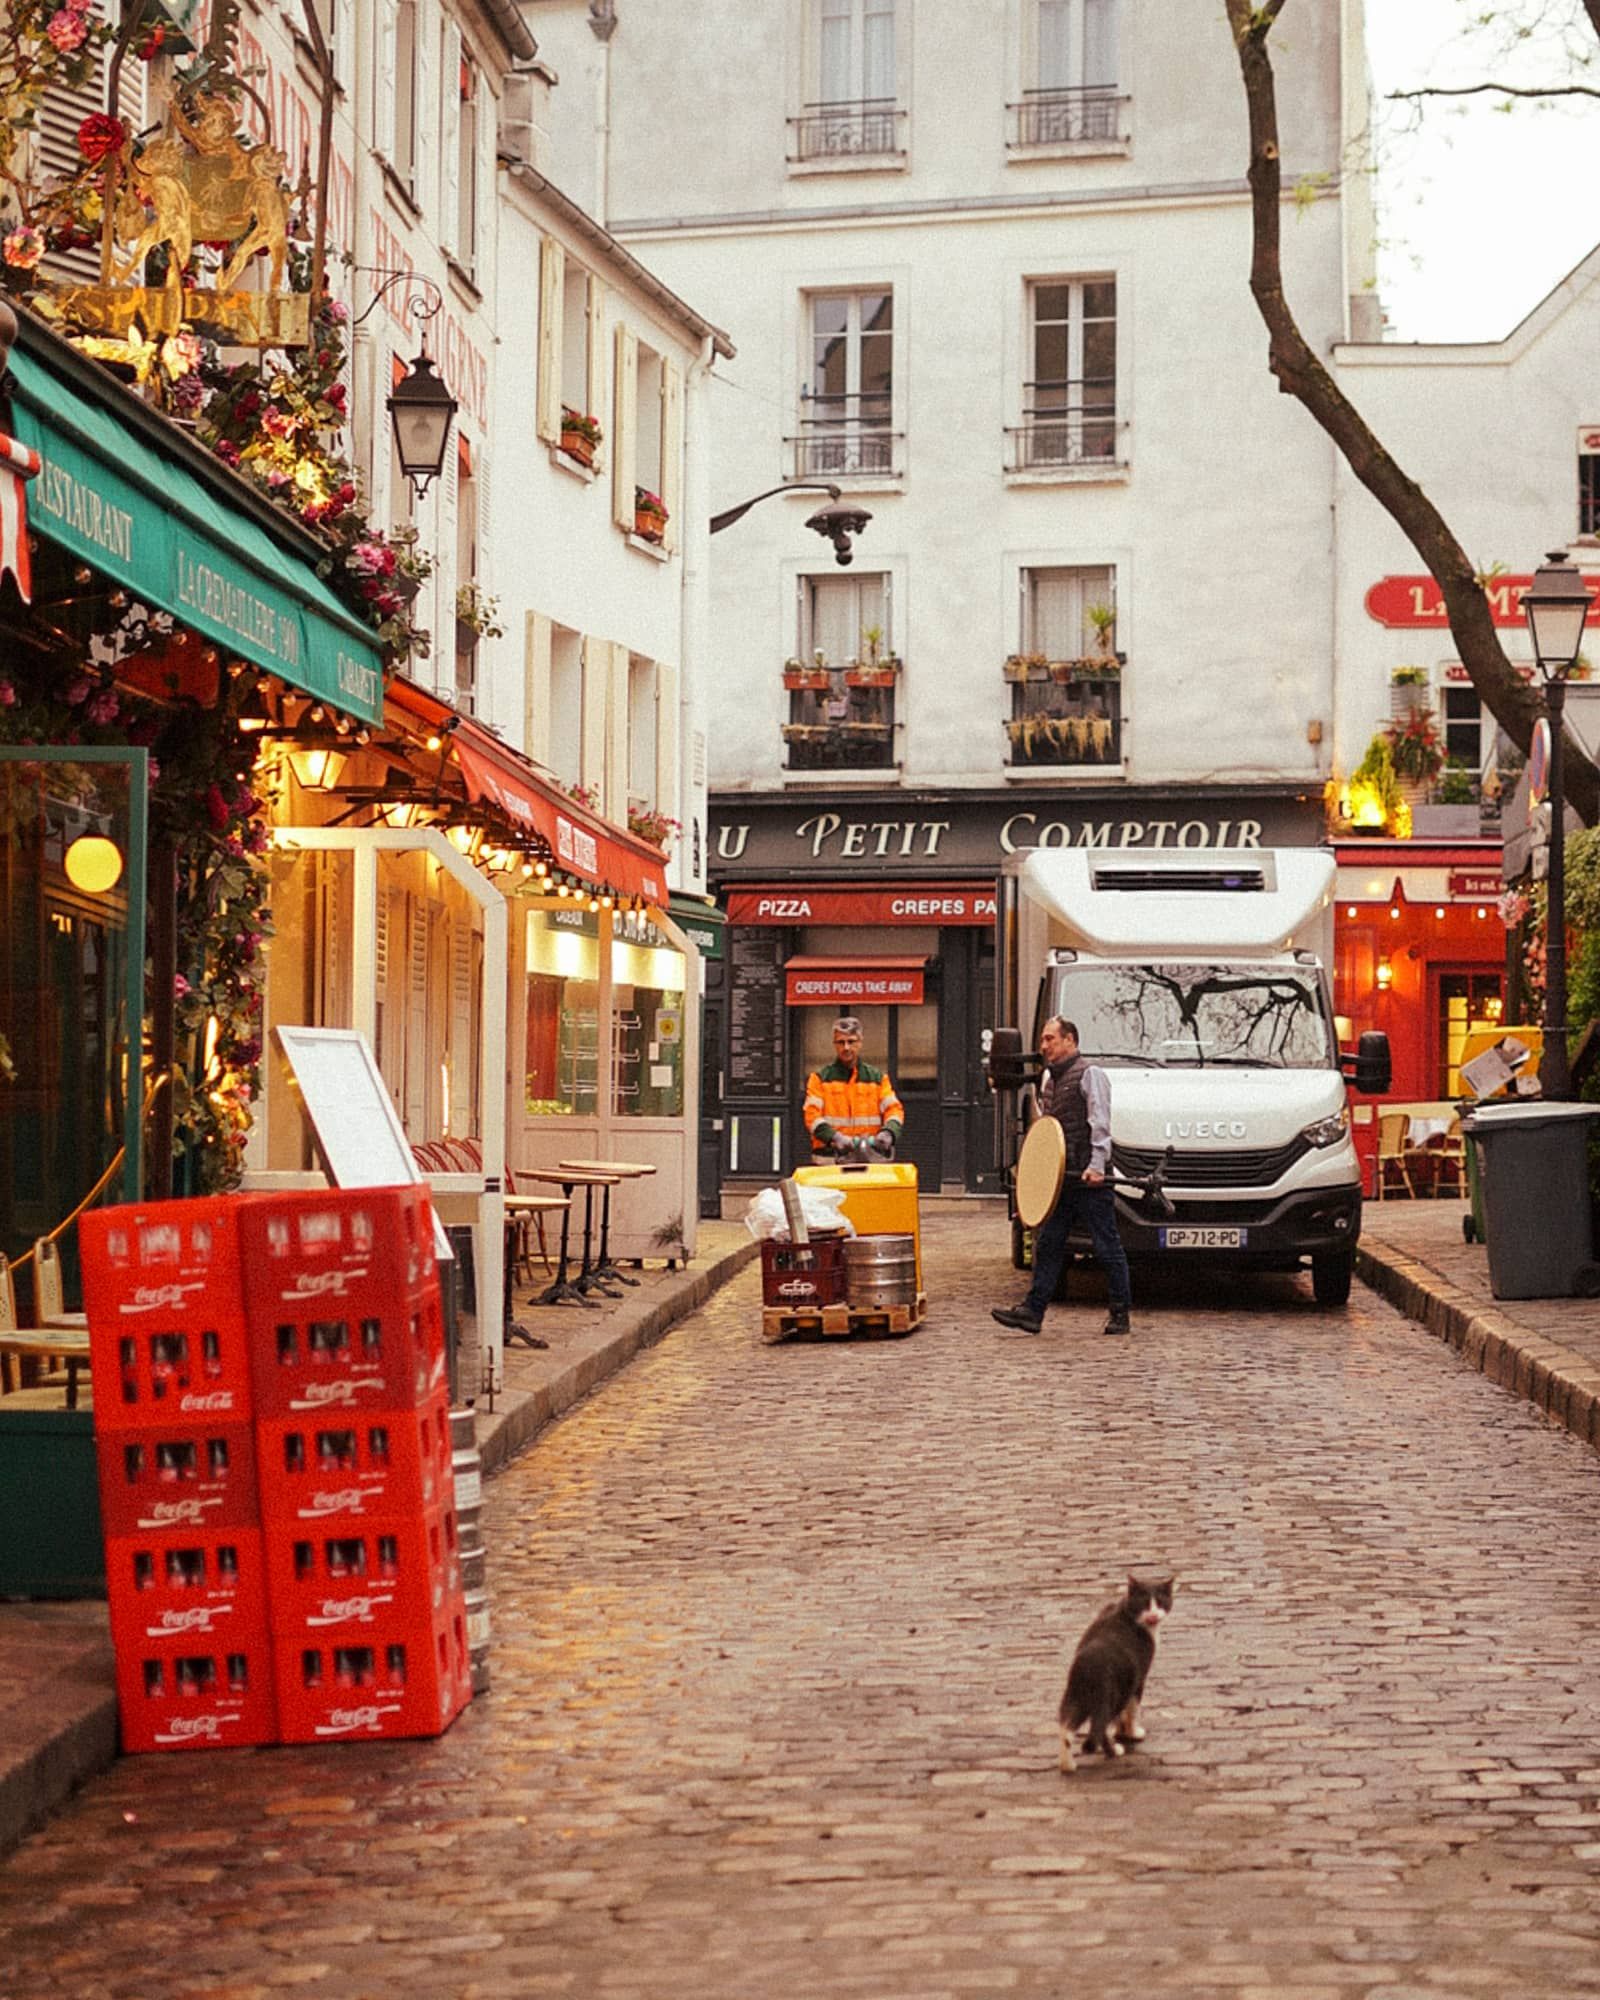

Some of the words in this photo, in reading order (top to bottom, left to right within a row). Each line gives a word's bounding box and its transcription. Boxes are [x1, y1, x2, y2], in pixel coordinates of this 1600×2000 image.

[36, 459, 132, 562] RESTAURANT
[796, 813, 949, 857] PETIT
[1000, 813, 1262, 854] COMPTOIR
[758, 900, 812, 917] PIZZA
[891, 899, 965, 915] CREPES
[795, 981, 830, 994] CREPES
[832, 981, 863, 994] PIZZAS
[864, 981, 887, 993] TAKE
[888, 981, 913, 993] AWAY
[1165, 1121, 1248, 1138] IVECO
